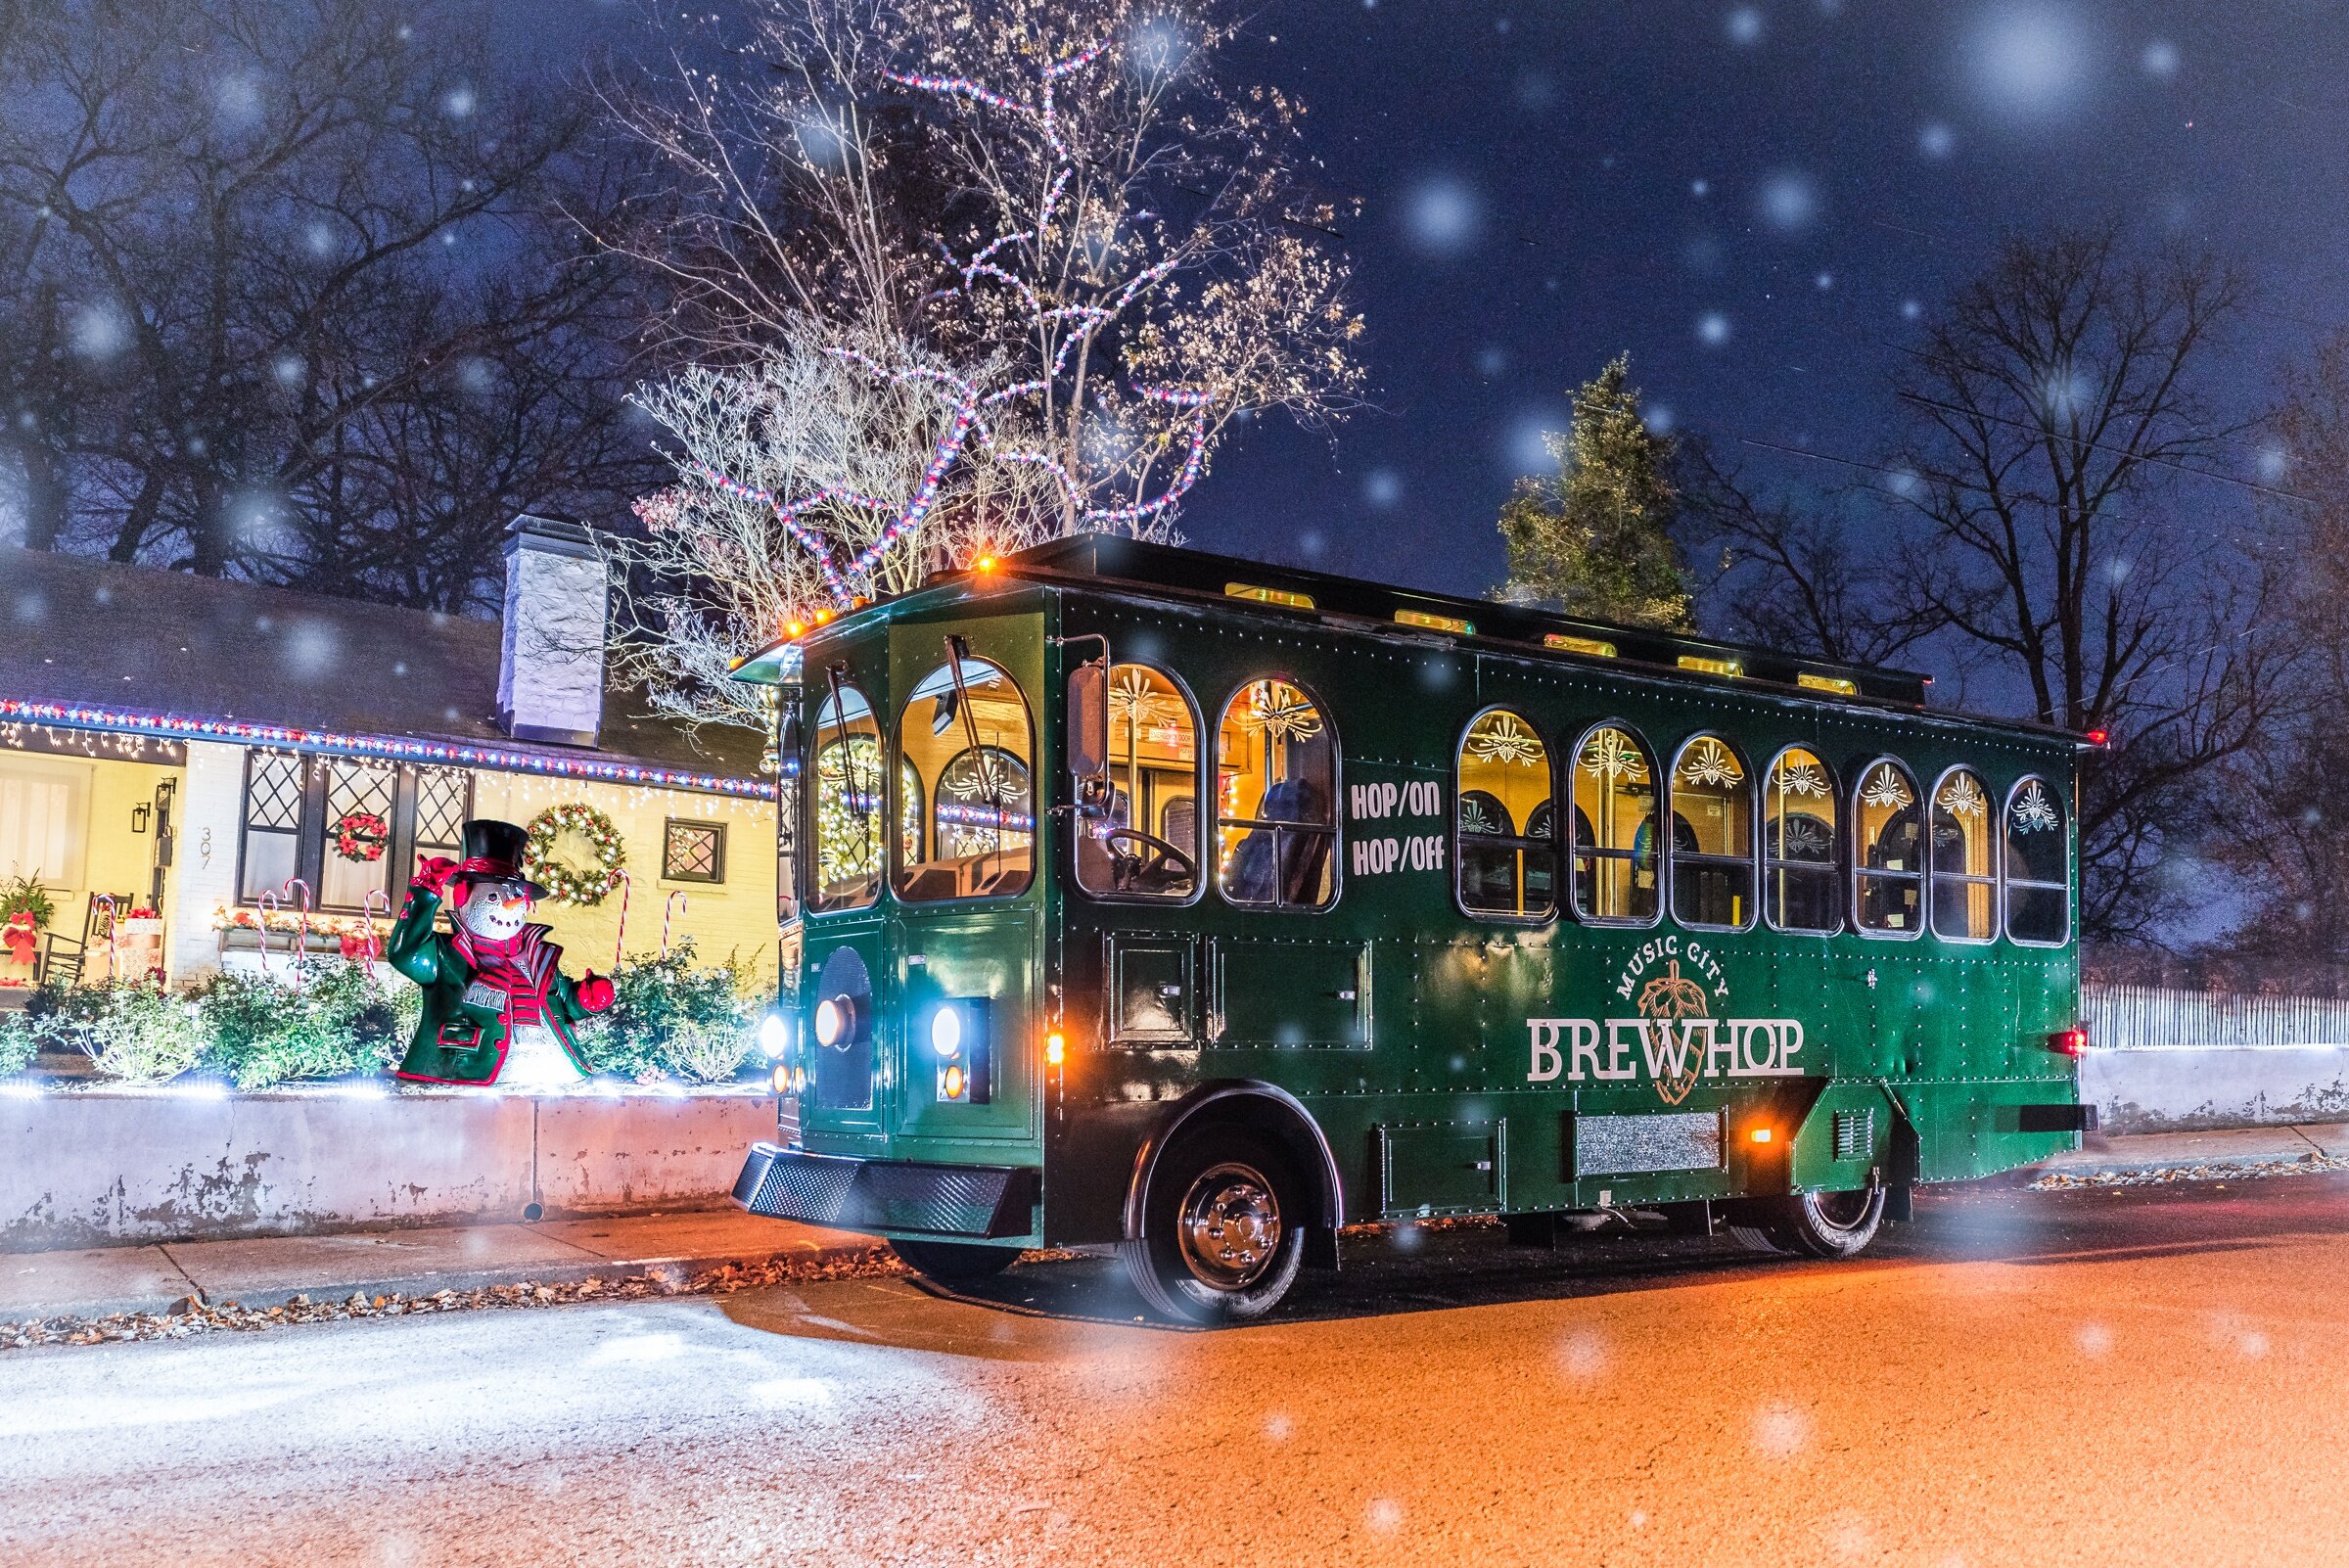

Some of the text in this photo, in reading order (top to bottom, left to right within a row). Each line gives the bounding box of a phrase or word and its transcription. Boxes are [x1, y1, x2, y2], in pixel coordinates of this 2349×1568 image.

[201, 827, 211, 869] 307
[1616, 935, 1729, 1000] MUSIC CITY
[1526, 1018, 1805, 1082] BREWHOP
